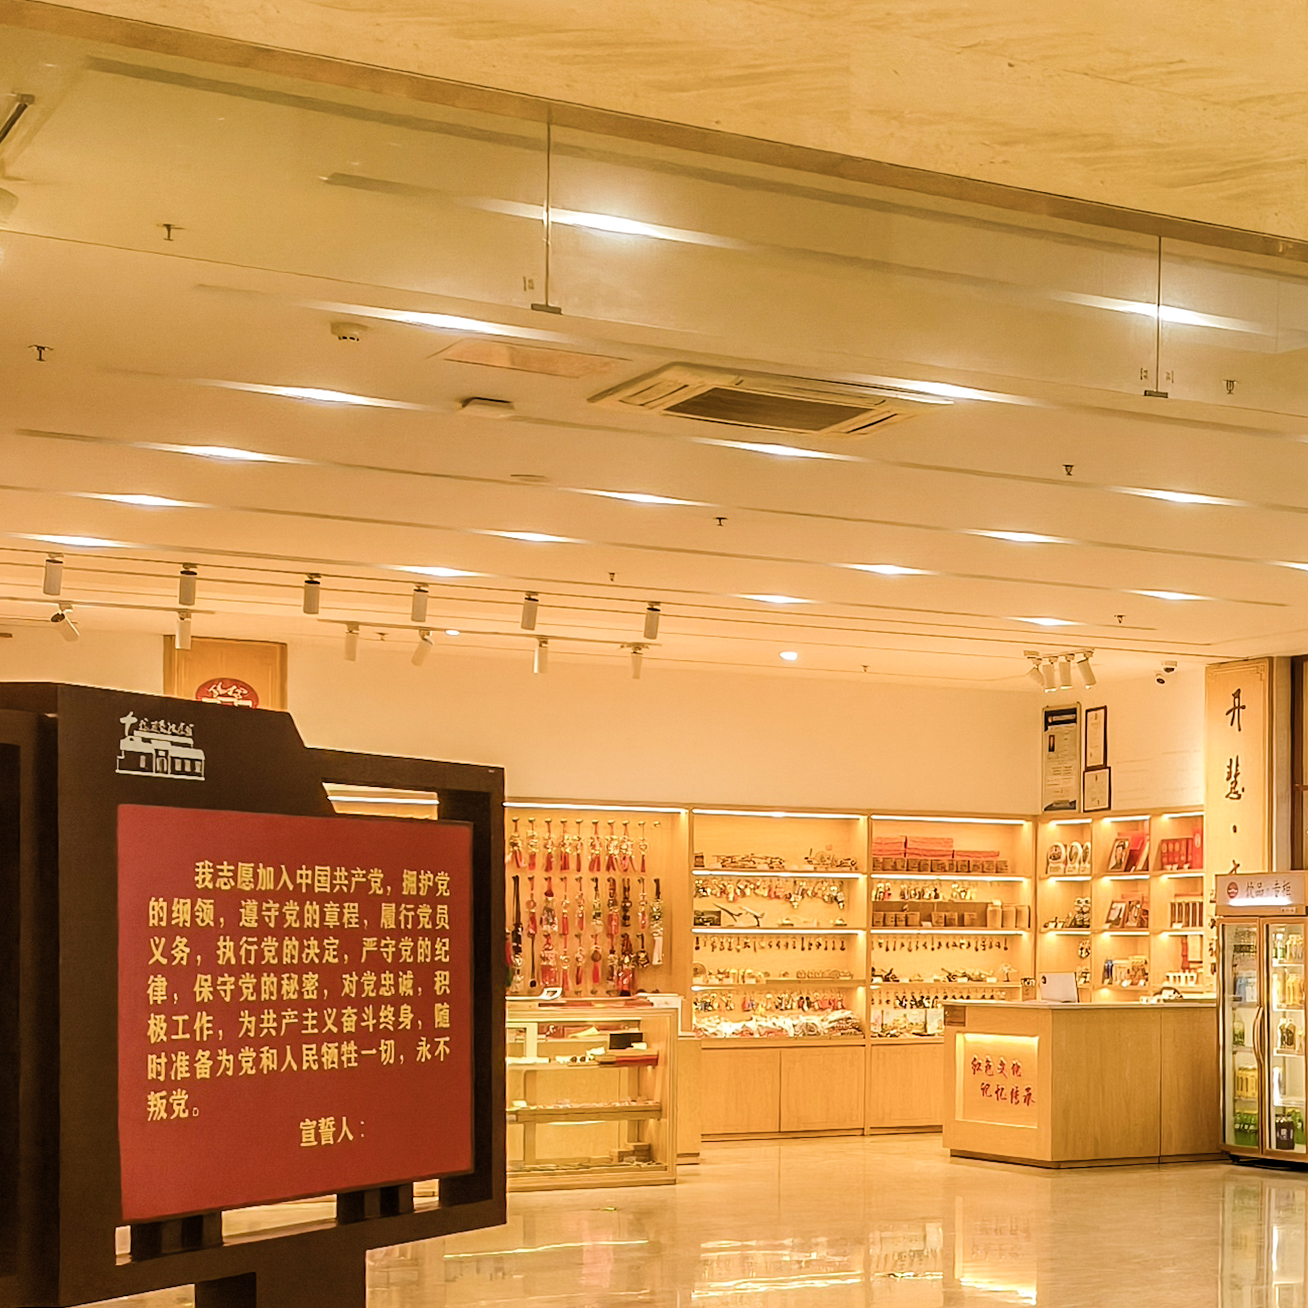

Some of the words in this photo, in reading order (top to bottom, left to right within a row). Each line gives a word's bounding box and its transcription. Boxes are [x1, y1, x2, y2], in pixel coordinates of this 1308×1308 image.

[194, 859, 451, 897] 我志愿加入中国共产党，拥护党
[148, 896, 451, 930] 的纲领，遵守党的章程，履行党员
[148, 935, 451, 967] 义务，执行党的决定，严守党的纪
[146, 970, 451, 1005] 律，保守党的秘密，对党忠诚，积
[146, 1002, 451, 1044] 极工作，为共产主义奋斗终身，随
[147, 1036, 451, 1082] 时准备为党和人民牺牲一切，永不
[970, 1055, 1023, 1079] 红色文化
[146, 1088, 201, 1121] 叛党。
[299, 1116, 365, 1147] 宣誓人：
